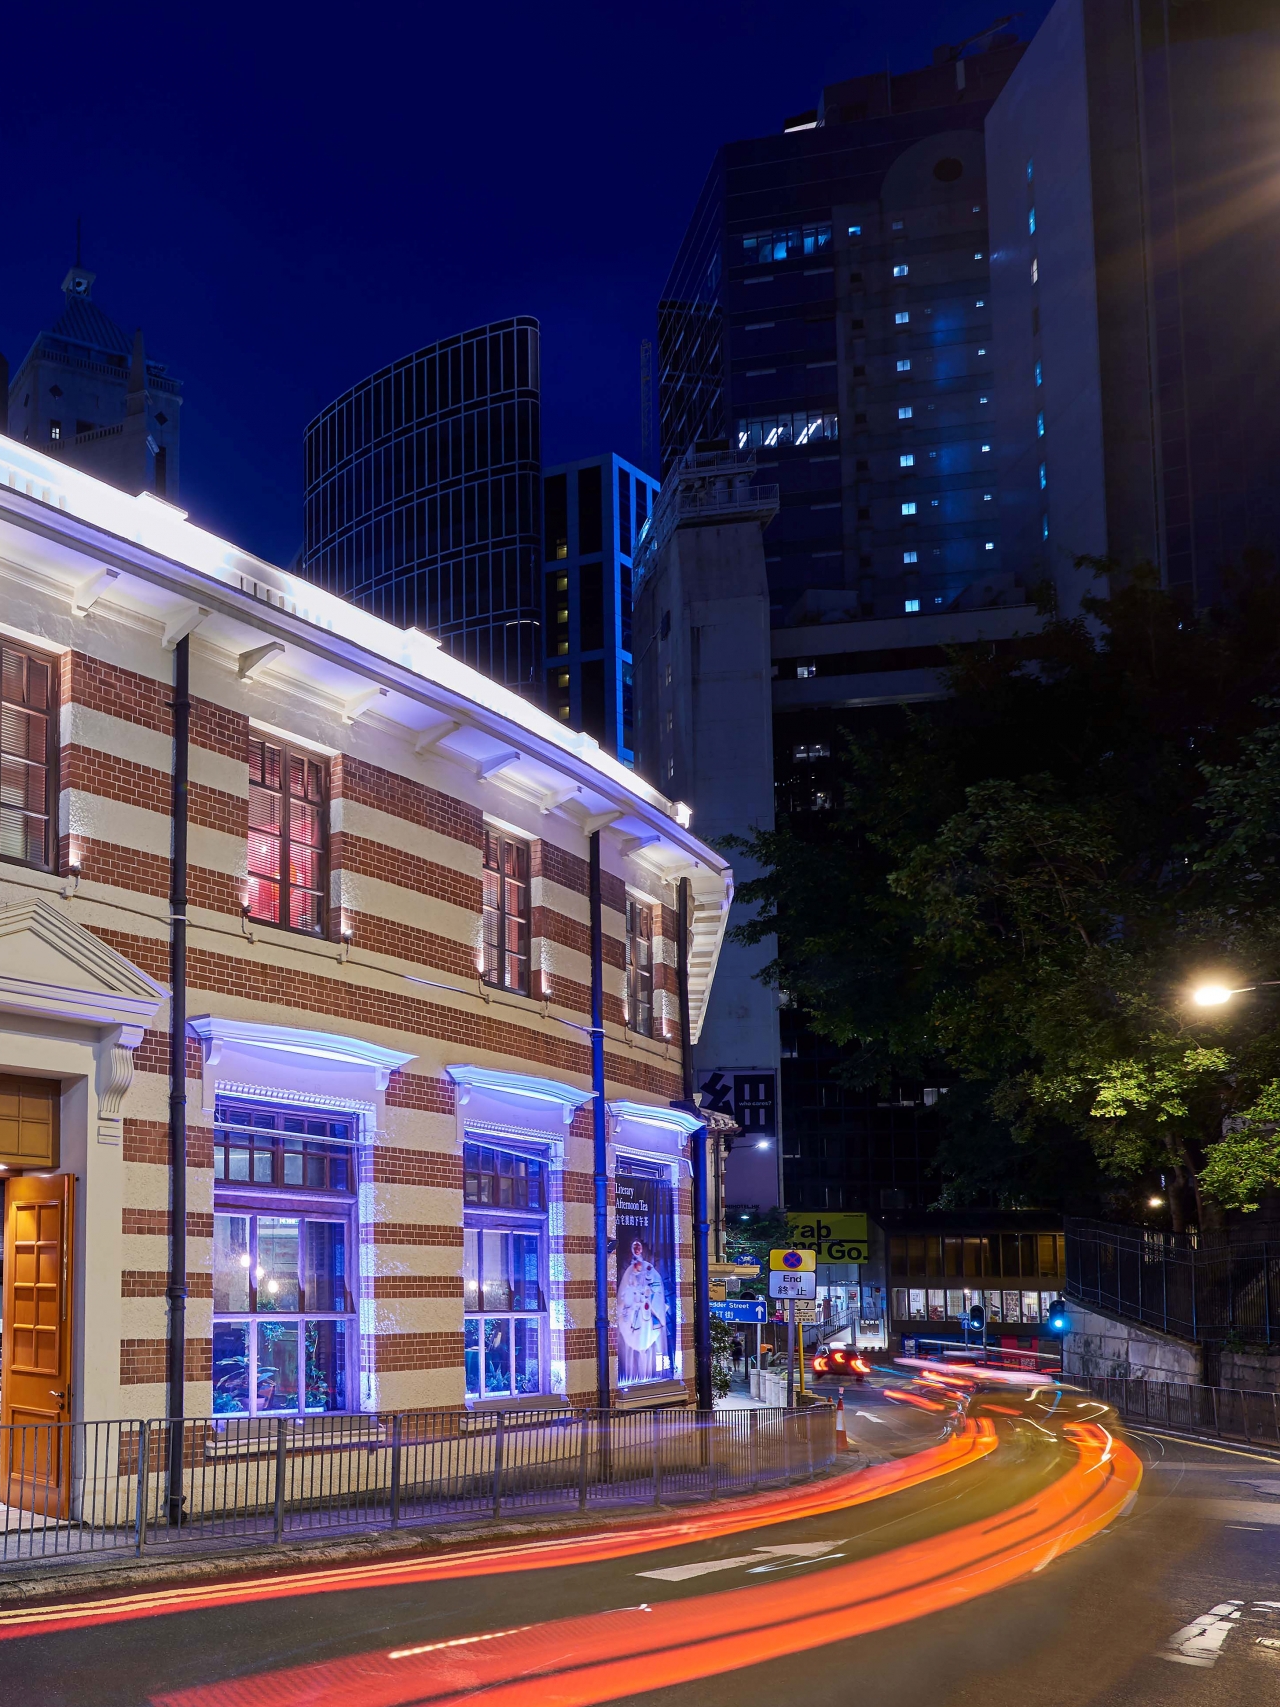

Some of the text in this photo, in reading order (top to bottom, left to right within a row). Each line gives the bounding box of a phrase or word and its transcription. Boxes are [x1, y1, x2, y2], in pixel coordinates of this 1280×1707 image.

[615, 1183, 634, 1199] Literary
[615, 1198, 648, 1212] Afternoon Tea
[827, 1242, 869, 1260] Go.
[783, 1274, 802, 1283] End
[777, 1285, 807, 1296] 終止
[728, 1302, 750, 1310] Street
